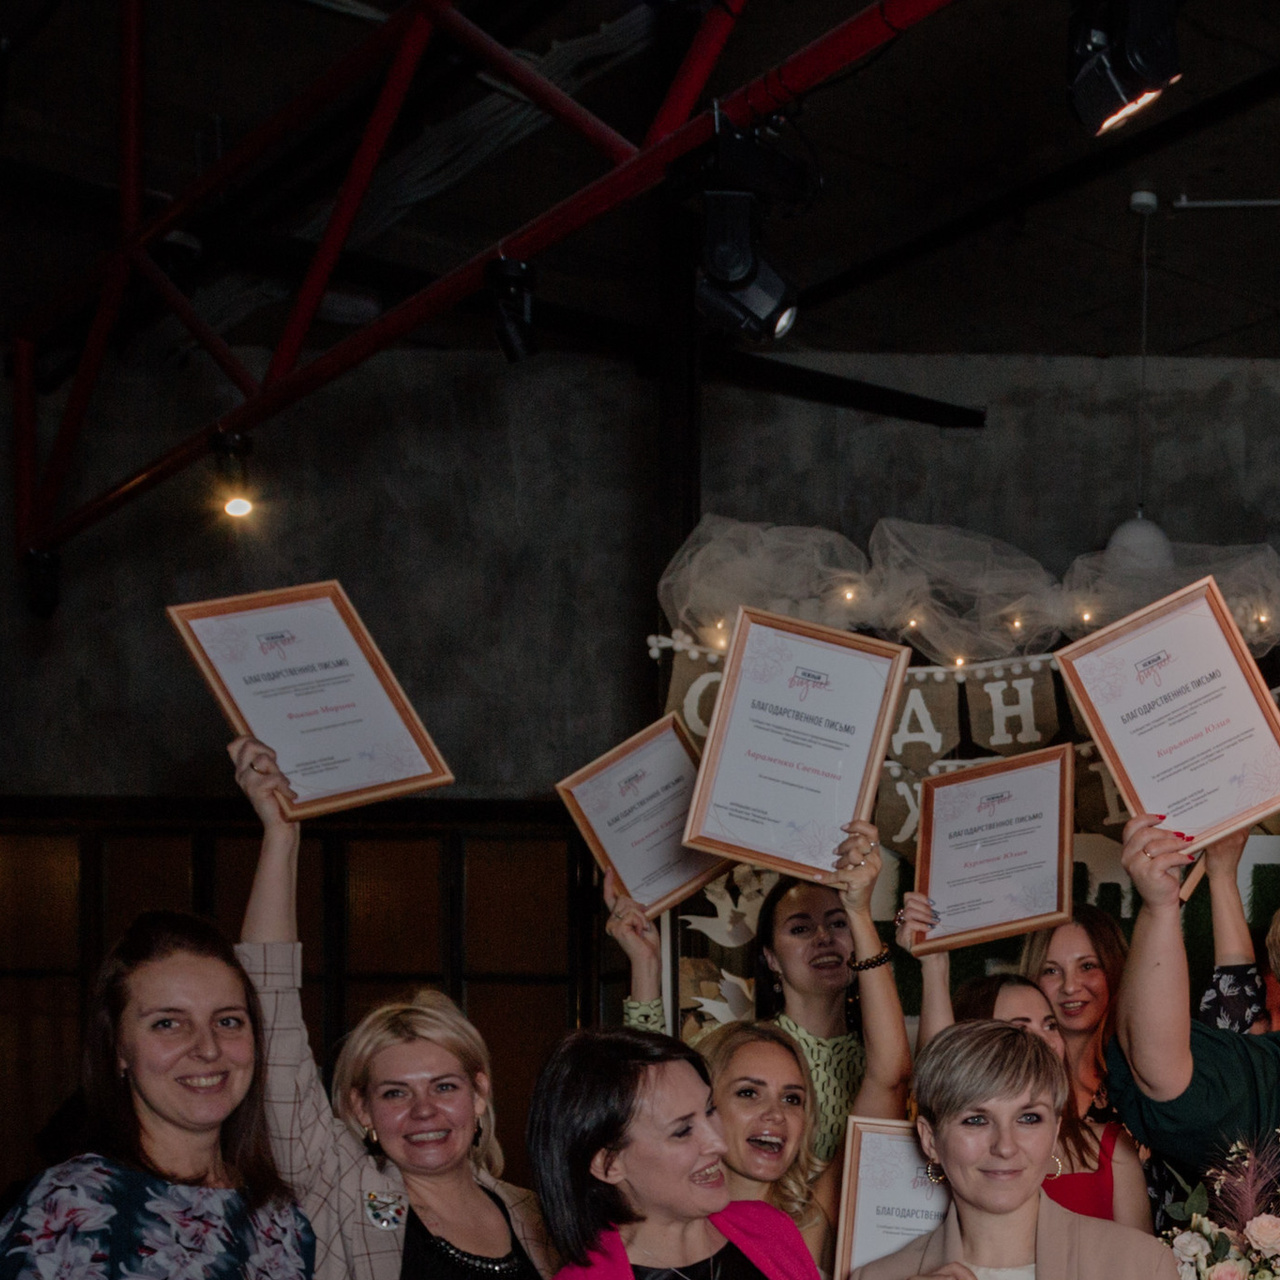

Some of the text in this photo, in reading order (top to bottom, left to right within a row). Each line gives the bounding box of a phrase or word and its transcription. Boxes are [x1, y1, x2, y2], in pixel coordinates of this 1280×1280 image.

[243, 658, 349, 685] БЛАГОДАРСТВЕННОЕ ПИСЬМО
[1121, 685, 1191, 724] БЛАГОДАРСТВЕННОЕ
[1192, 669, 1222, 690] ПИСЬМО
[751, 699, 823, 727] БЛАГОДАРСТВЕННОЕ
[824, 719, 855, 735] ПИСЬМО
[1205, 718, 1231, 734] Юлия
[796, 762, 842, 781] Светлана
[948, 818, 1013, 840] БЛАГОДАРСТВЕННОЕ
[1015, 812, 1042, 823] ПИСЬМО
[876, 1206, 943, 1220] БЛАГОДАРСТВЕНН
